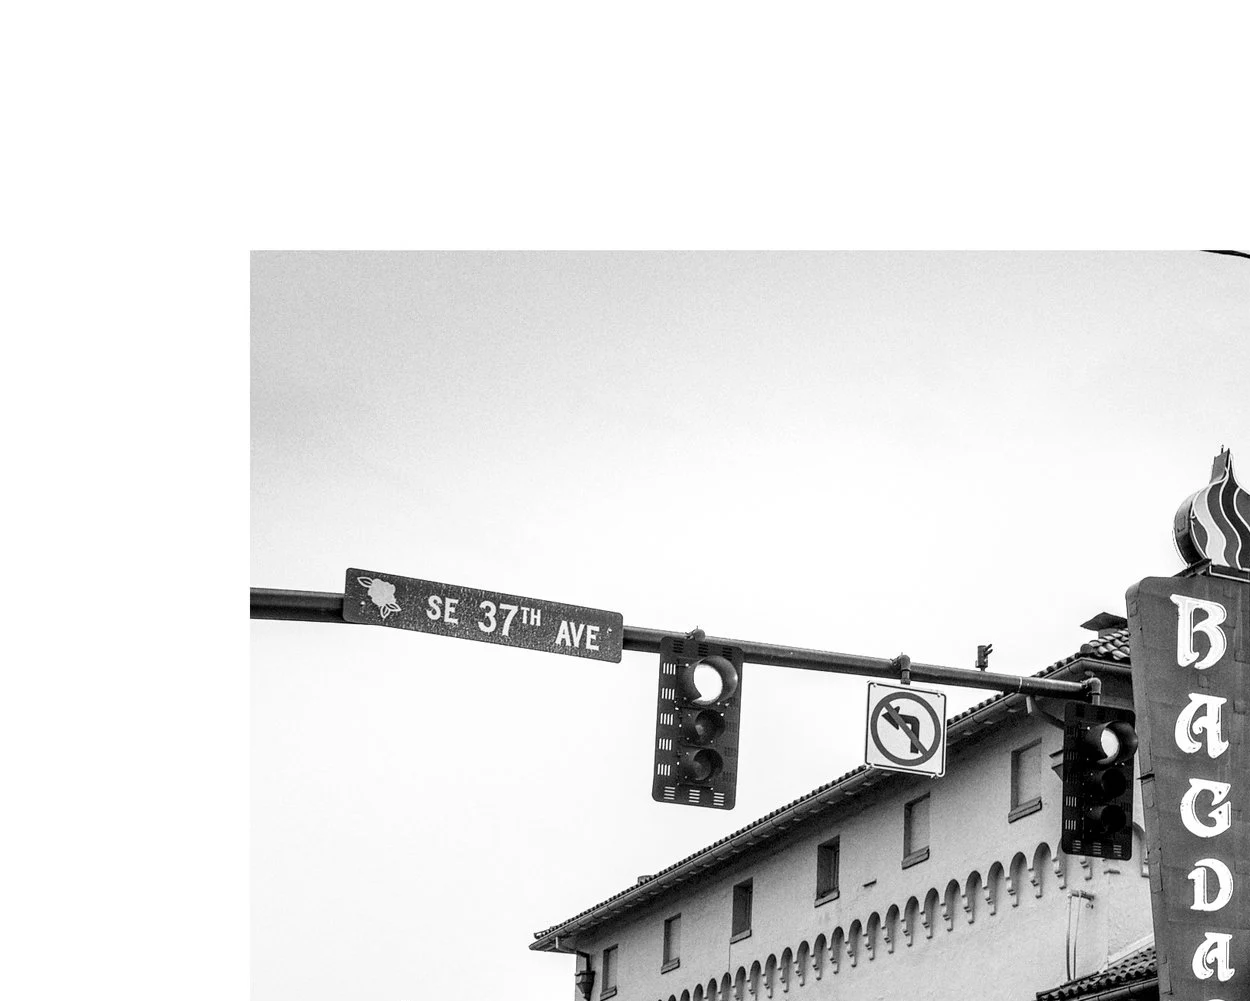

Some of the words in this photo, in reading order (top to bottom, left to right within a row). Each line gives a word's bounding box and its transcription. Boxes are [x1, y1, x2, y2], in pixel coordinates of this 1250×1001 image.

[426, 595, 459, 624] SE
[477, 601, 541, 636] 37TH
[555, 620, 600, 650] AVE
